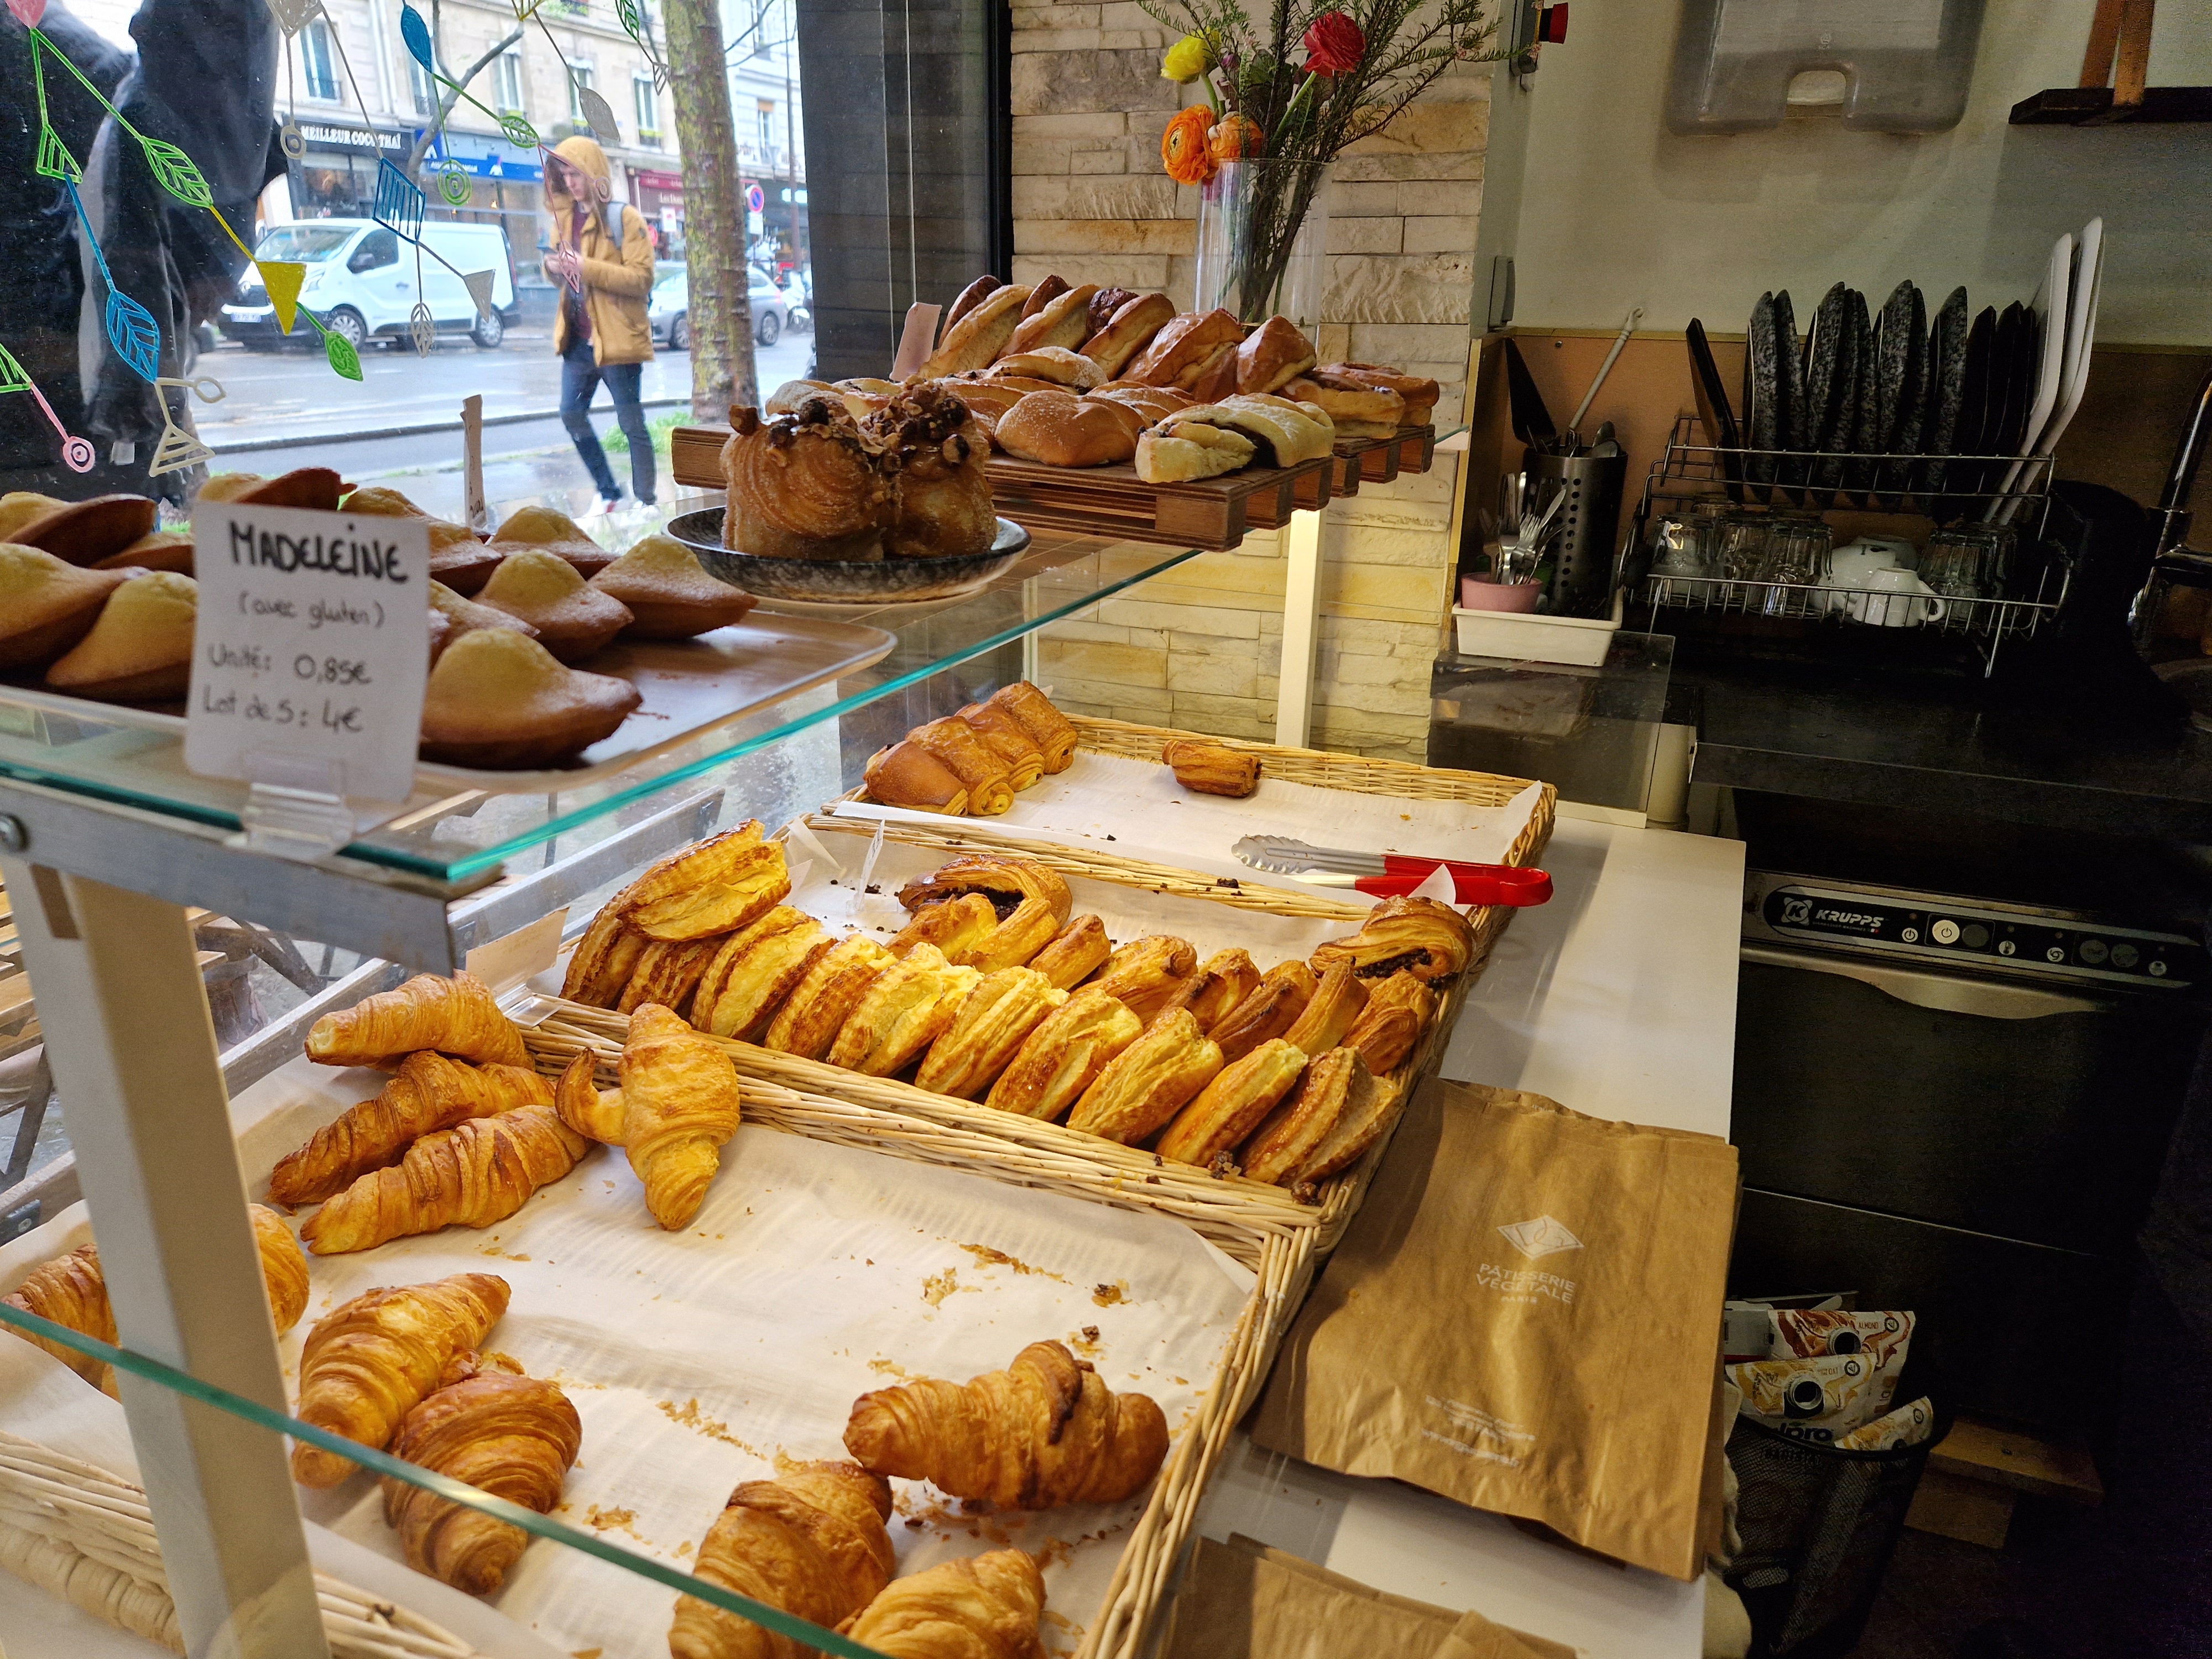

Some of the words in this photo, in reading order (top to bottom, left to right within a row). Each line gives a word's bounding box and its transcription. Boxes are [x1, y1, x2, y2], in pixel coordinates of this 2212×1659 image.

[228, 520, 408, 583] MADELEINE
[202, 685, 236, 715] Lot
[1815, 909, 1885, 928] KRUPPS
[1479, 1262, 1576, 1293] PÂTISSERIE
[1858, 1321, 1879, 1330] ALMOND
[1776, 1422, 1833, 1442] lpro
